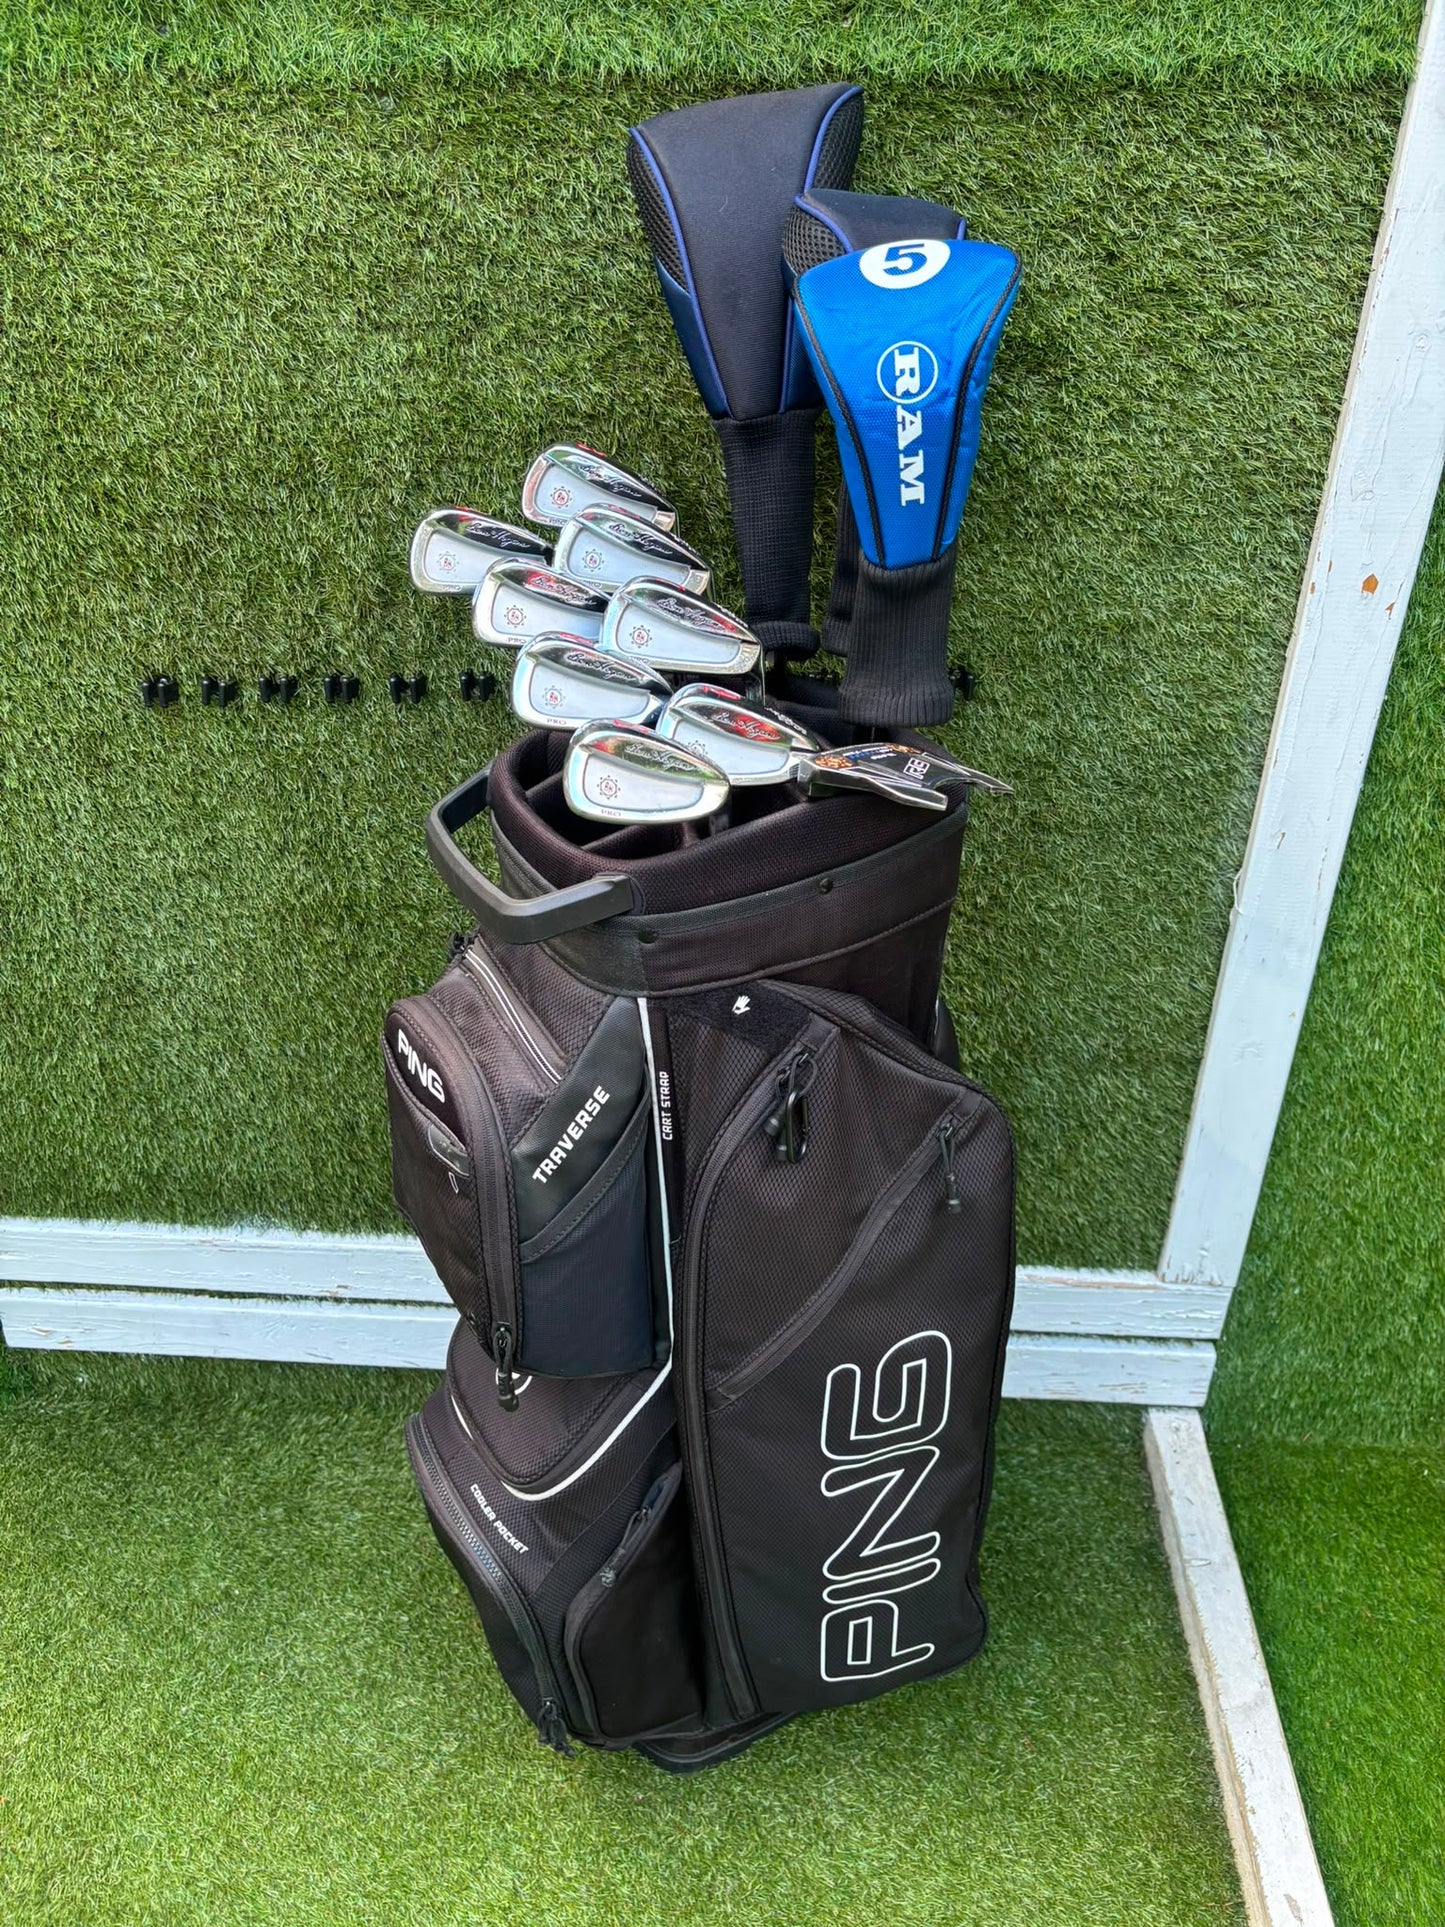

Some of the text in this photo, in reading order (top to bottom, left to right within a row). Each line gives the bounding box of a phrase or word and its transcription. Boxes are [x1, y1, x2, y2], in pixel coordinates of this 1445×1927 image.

[882, 243, 928, 276] 5
[891, 344, 929, 506] RAM
[398, 1028, 446, 1104] PING
[532, 1085, 611, 1184] TRAVERSE
[659, 1071, 673, 1141] CART STRAP
[470, 1483, 529, 1554] COOLER POCKET
[820, 1329, 953, 1682] PING
